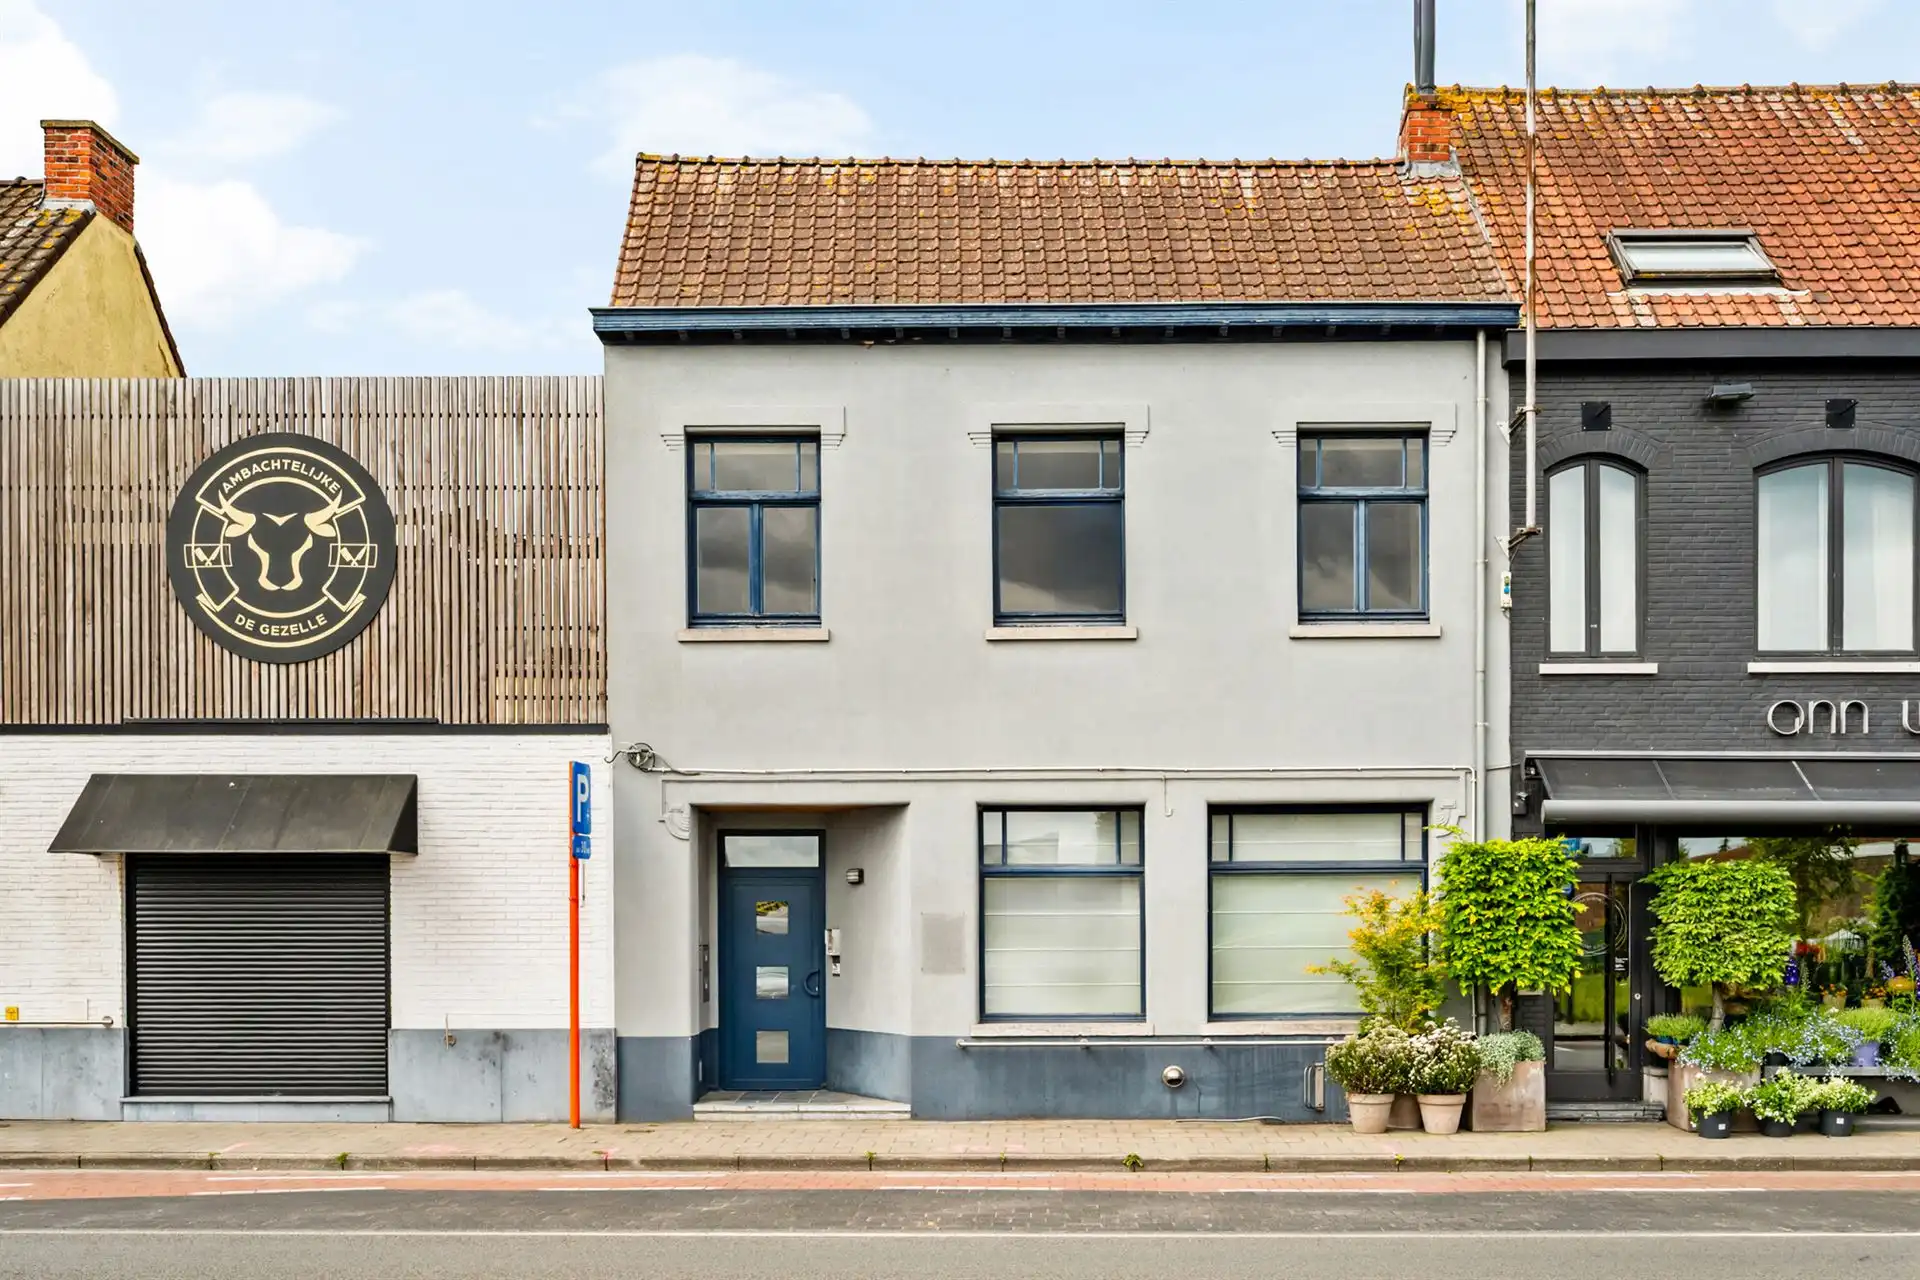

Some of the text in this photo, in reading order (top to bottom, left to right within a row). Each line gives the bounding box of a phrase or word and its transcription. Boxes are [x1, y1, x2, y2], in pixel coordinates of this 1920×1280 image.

[222, 459, 341, 494] AMBACHTELIJKE
[234, 613, 328, 636] DE GEZELLE
[577, 774, 589, 823] P
